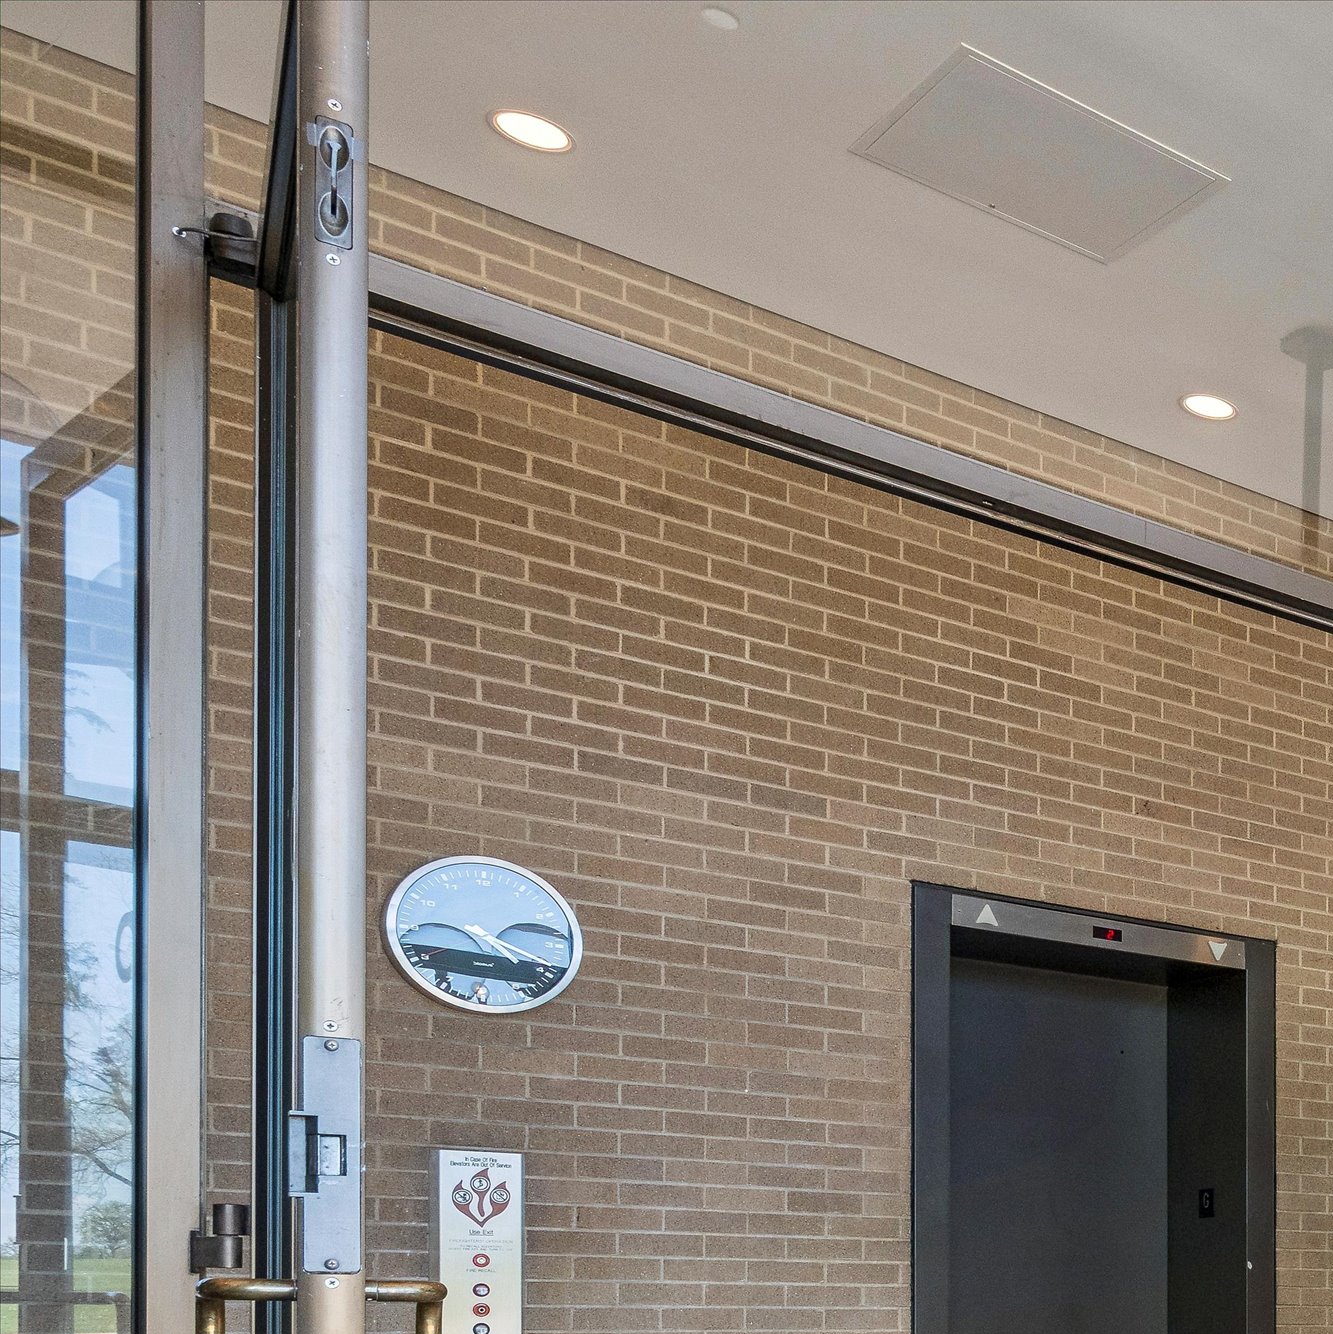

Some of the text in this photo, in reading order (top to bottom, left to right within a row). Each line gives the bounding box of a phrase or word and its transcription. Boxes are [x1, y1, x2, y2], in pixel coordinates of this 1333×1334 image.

[475, 879, 492, 887] 12
[420, 899, 436, 907] 10
[1106, 930, 1114, 940] 2
[1203, 1192, 1209, 1208] G
